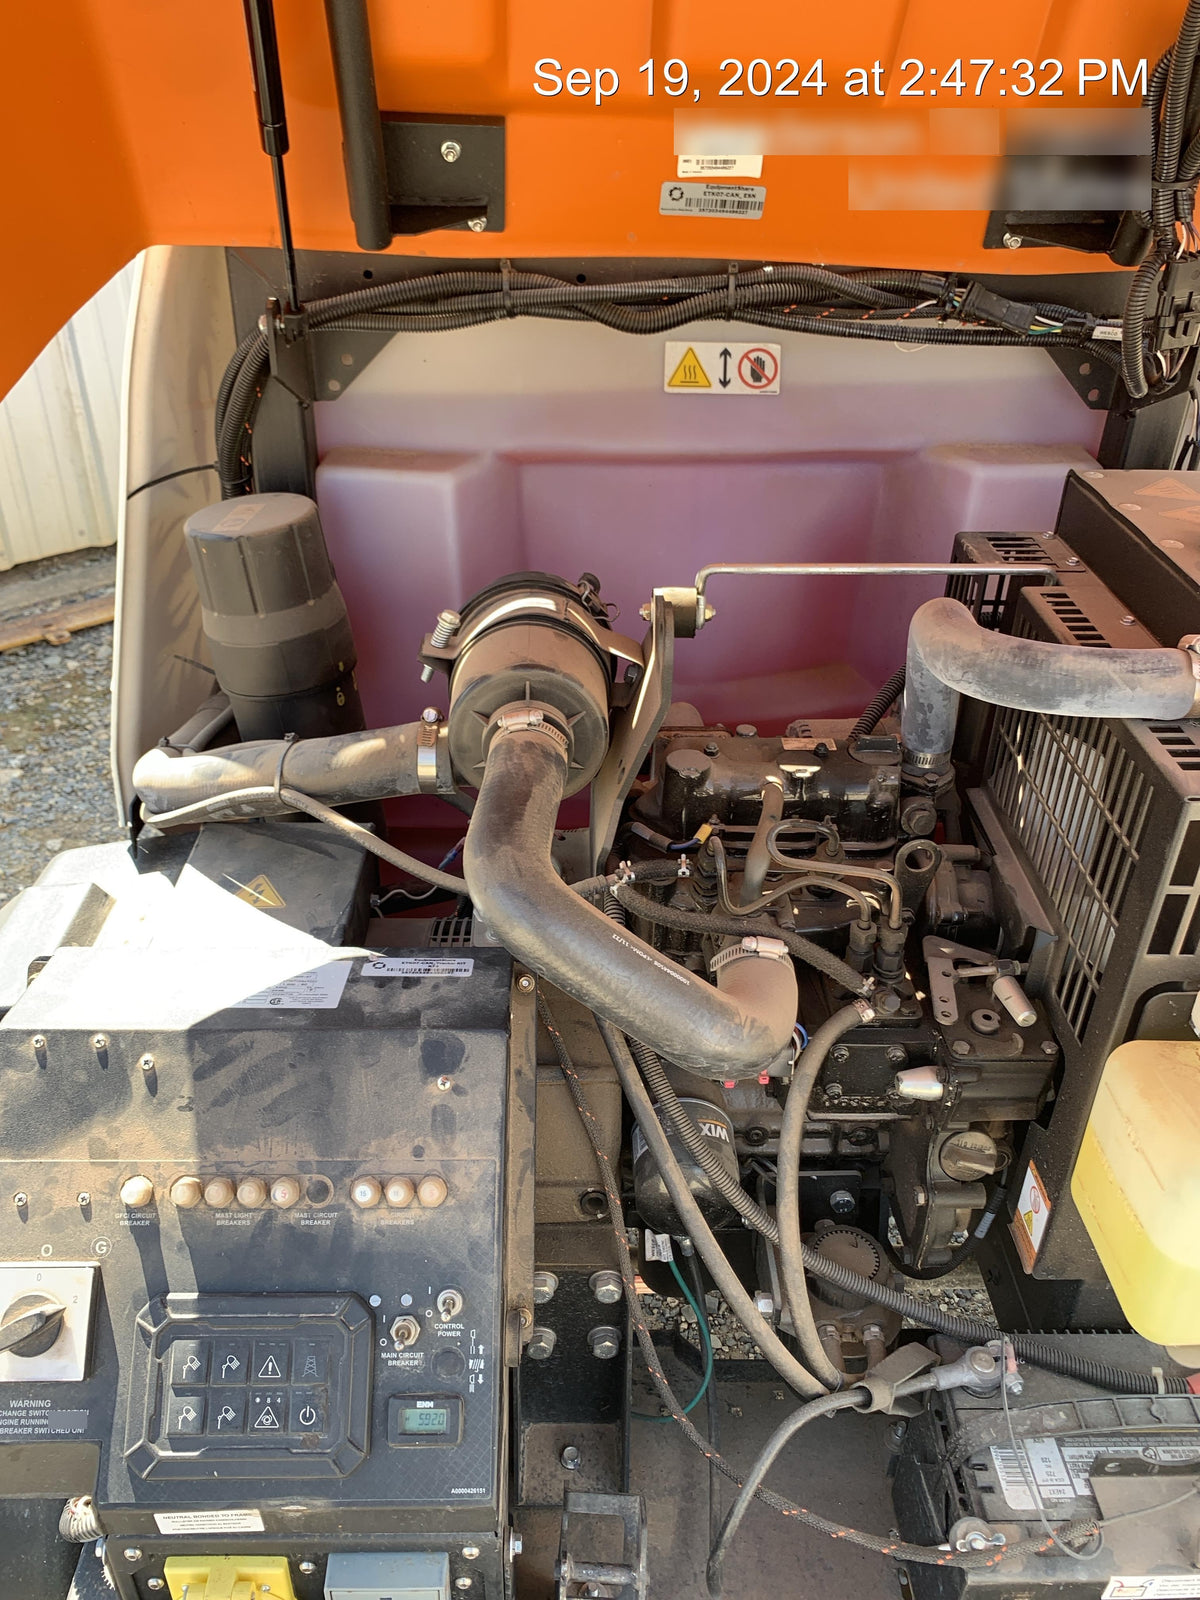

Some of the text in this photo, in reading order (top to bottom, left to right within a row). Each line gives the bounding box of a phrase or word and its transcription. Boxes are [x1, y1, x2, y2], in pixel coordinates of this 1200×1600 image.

[697, 1122, 730, 1143] WIX
[72, 1295, 79, 1304] 2
[9, 1399, 52, 1408] WARNING
[28, 1409, 55, 1417] SWITC
[0, 1427, 33, 1435] BREAKER
